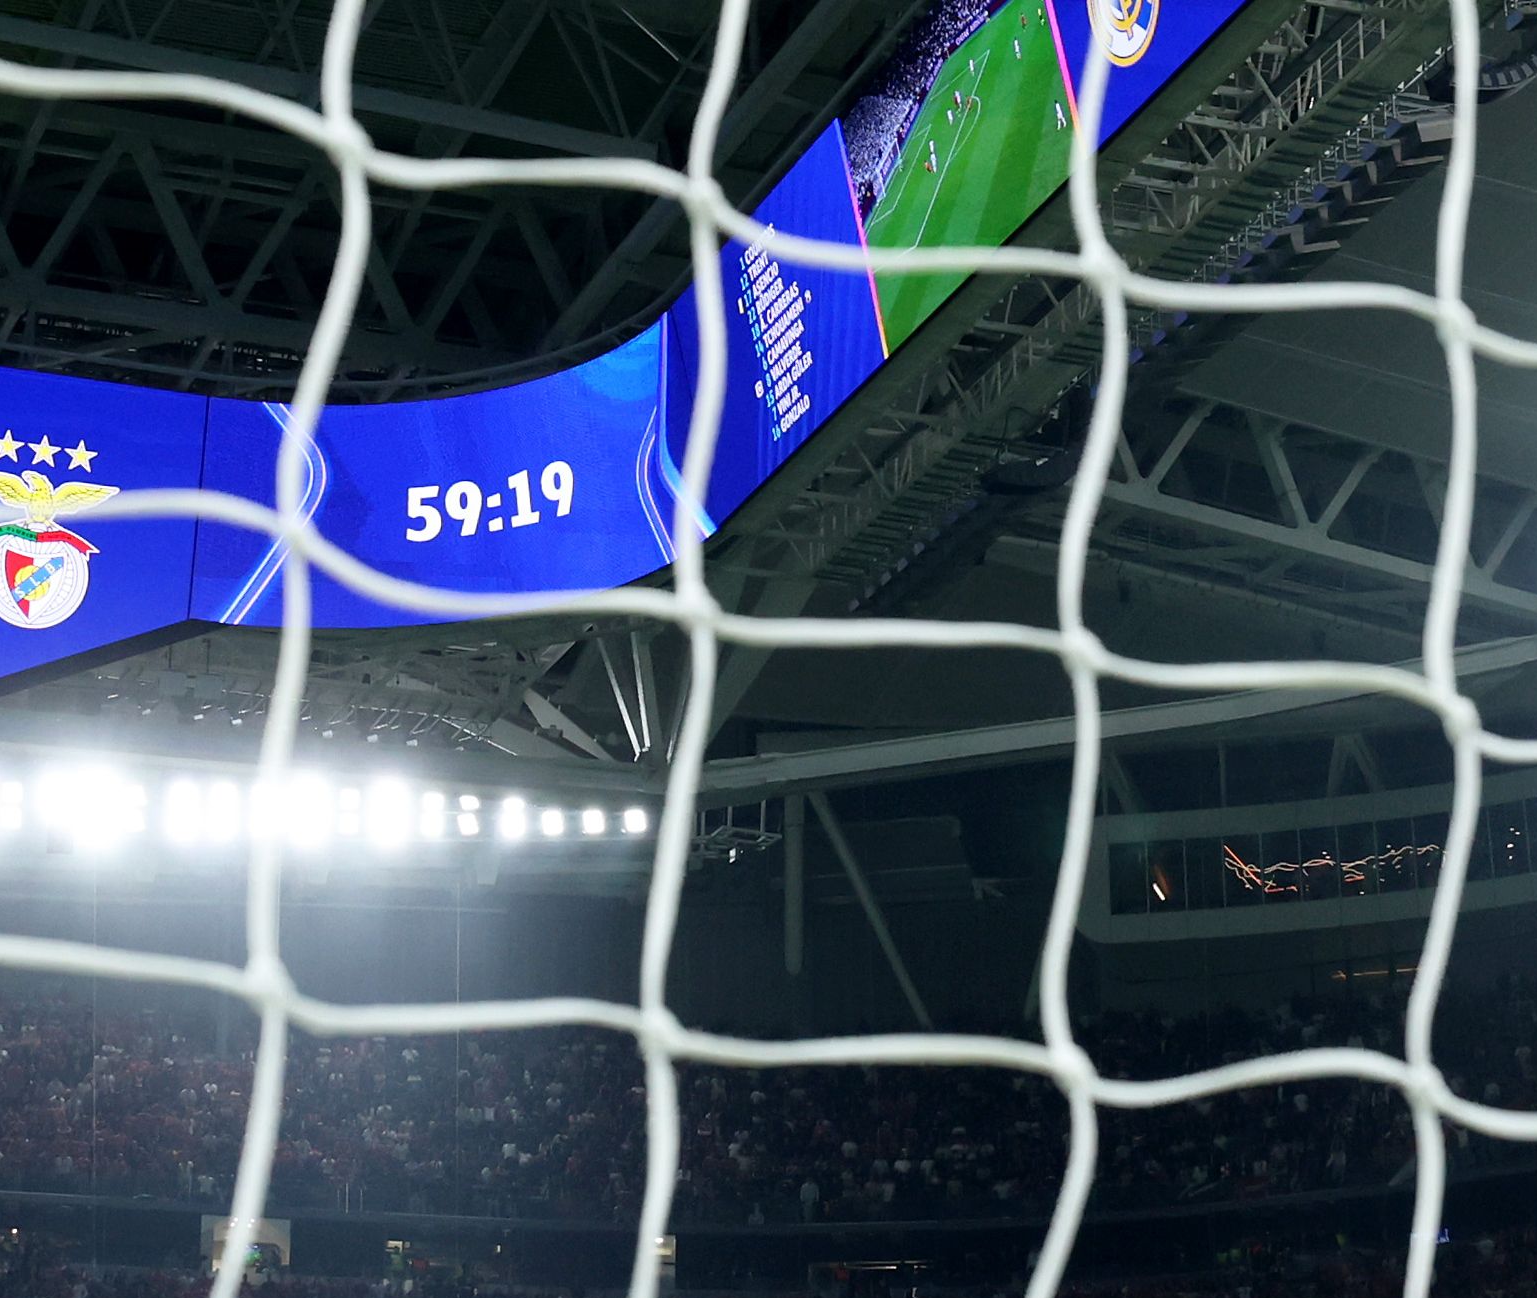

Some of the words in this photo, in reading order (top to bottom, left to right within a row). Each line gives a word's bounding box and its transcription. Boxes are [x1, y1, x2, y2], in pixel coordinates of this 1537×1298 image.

[739, 257, 745, 270] 1
[740, 273, 749, 291] 12
[748, 251, 769, 281] TRENT
[744, 289, 752, 308] 17
[753, 261, 779, 299] ASENCIO
[747, 306, 756, 325] 22
[767, 319, 804, 365] CAMAVINGA
[770, 340, 802, 381] VALVERDE
[766, 389, 775, 407] 15
[774, 372, 793, 400] ARDA
[772, 405, 777, 421] 7
[777, 392, 792, 415] VINI
[780, 394, 811, 433] GONZALO
[405, 461, 574, 542] 59:19
